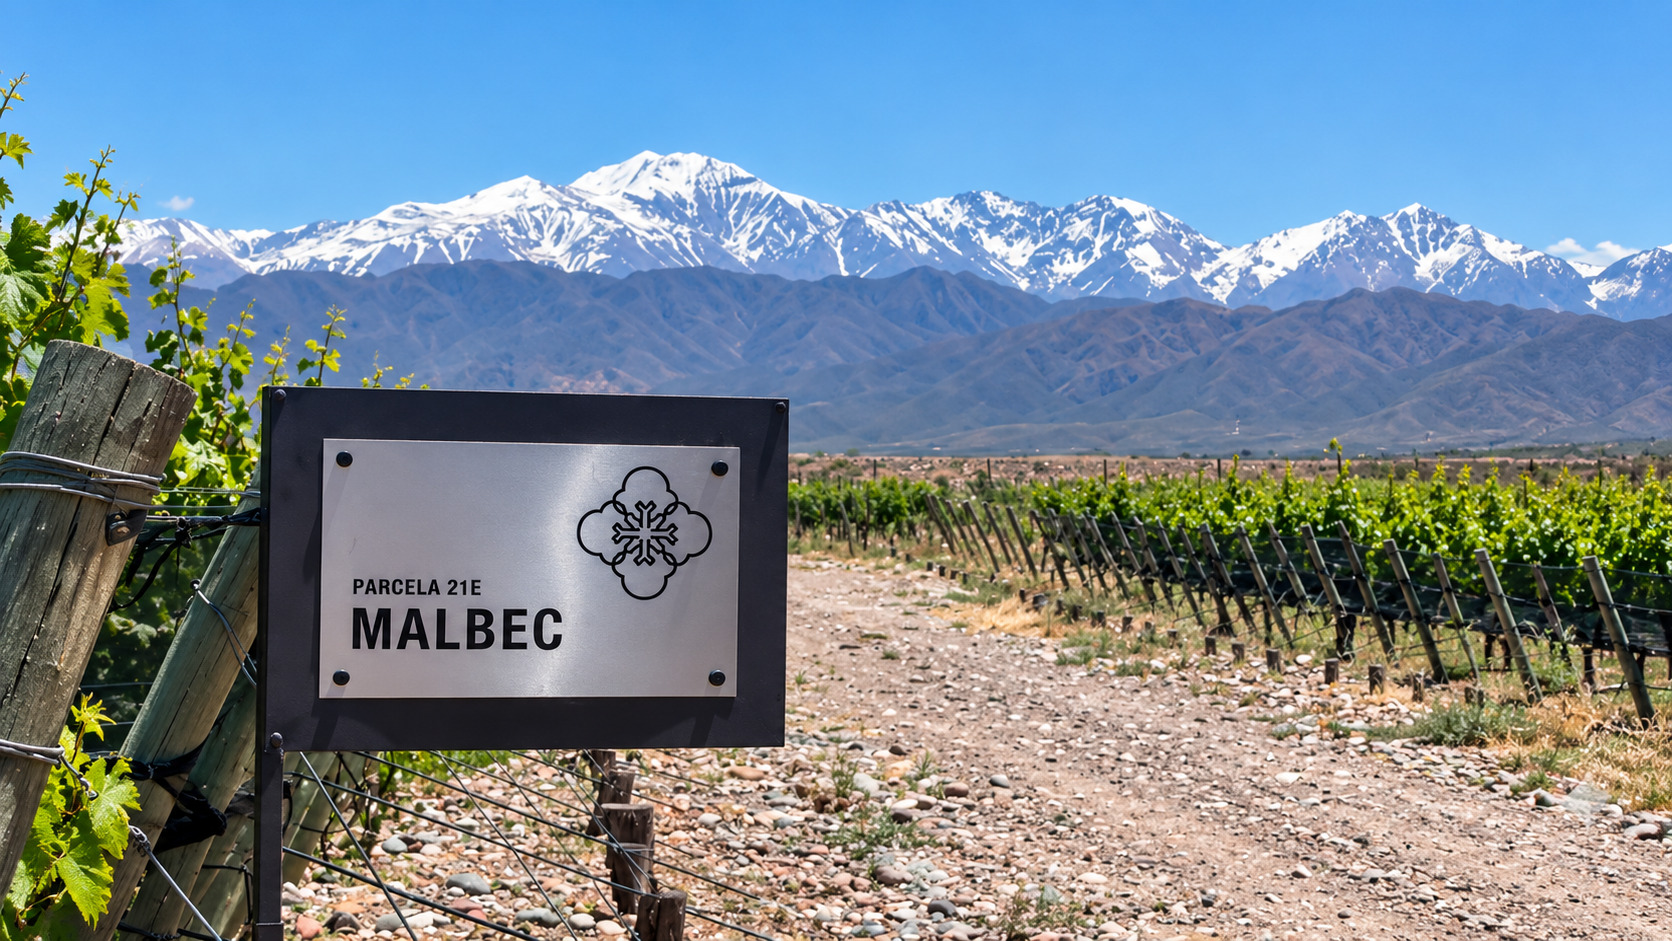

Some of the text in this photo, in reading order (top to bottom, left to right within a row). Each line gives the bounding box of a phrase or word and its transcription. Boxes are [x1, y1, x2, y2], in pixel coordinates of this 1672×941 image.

[352, 578, 482, 596] PARCELA 21E
[352, 607, 563, 651] MALBEC
